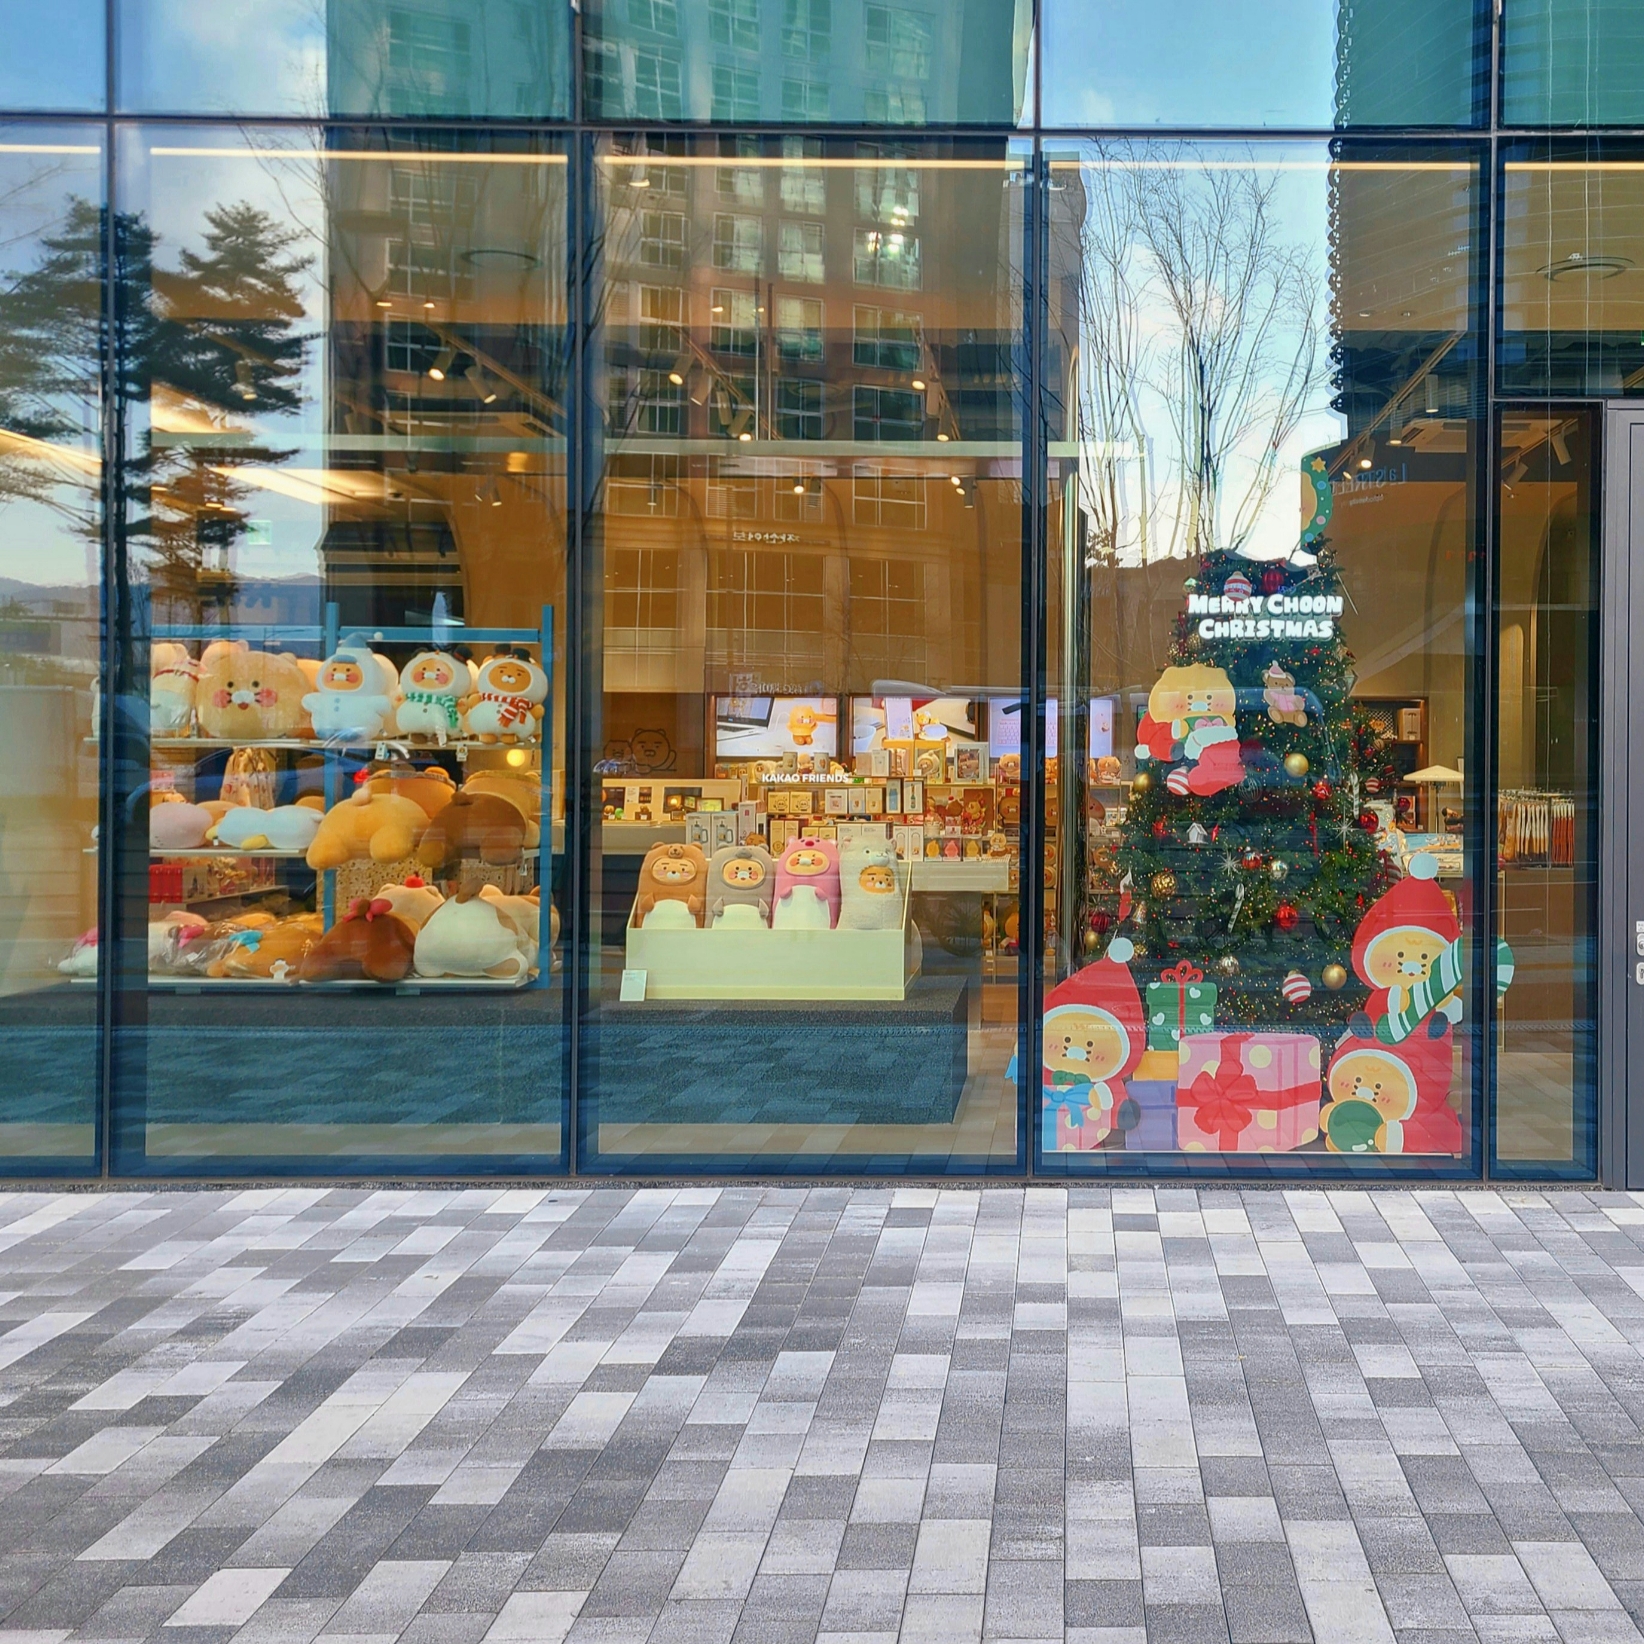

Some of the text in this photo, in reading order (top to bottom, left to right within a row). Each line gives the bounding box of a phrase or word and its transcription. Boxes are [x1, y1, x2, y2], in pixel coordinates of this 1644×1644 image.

[1188, 593, 1344, 616] MERRY CHOON
[1199, 618, 1335, 641] CHRISTMAS
[762, 773, 849, 783] KAKAO FRIENDS
